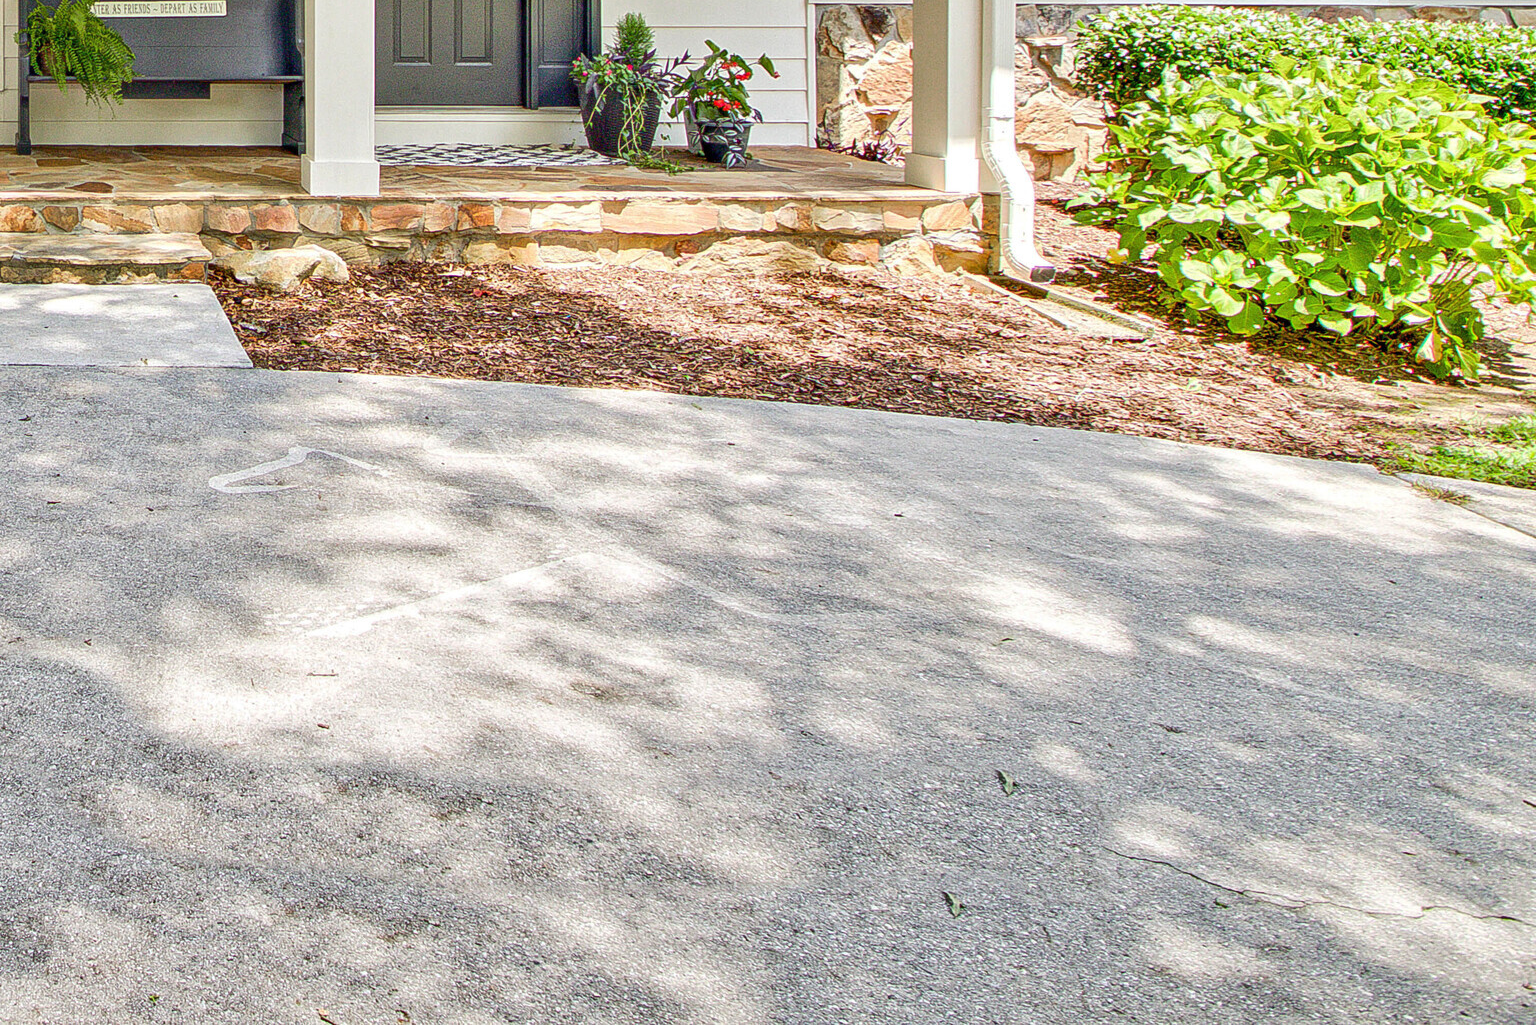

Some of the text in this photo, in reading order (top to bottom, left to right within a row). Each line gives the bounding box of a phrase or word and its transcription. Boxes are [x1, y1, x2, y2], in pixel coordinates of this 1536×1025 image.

[92, 4, 110, 15] NTER
[112, 3, 121, 14] AS
[124, 3, 151, 14] FRIENDS
[160, 2, 185, 13] DEPART
[188, 2, 197, 13] AS
[199, 1, 224, 13] FAMILY
